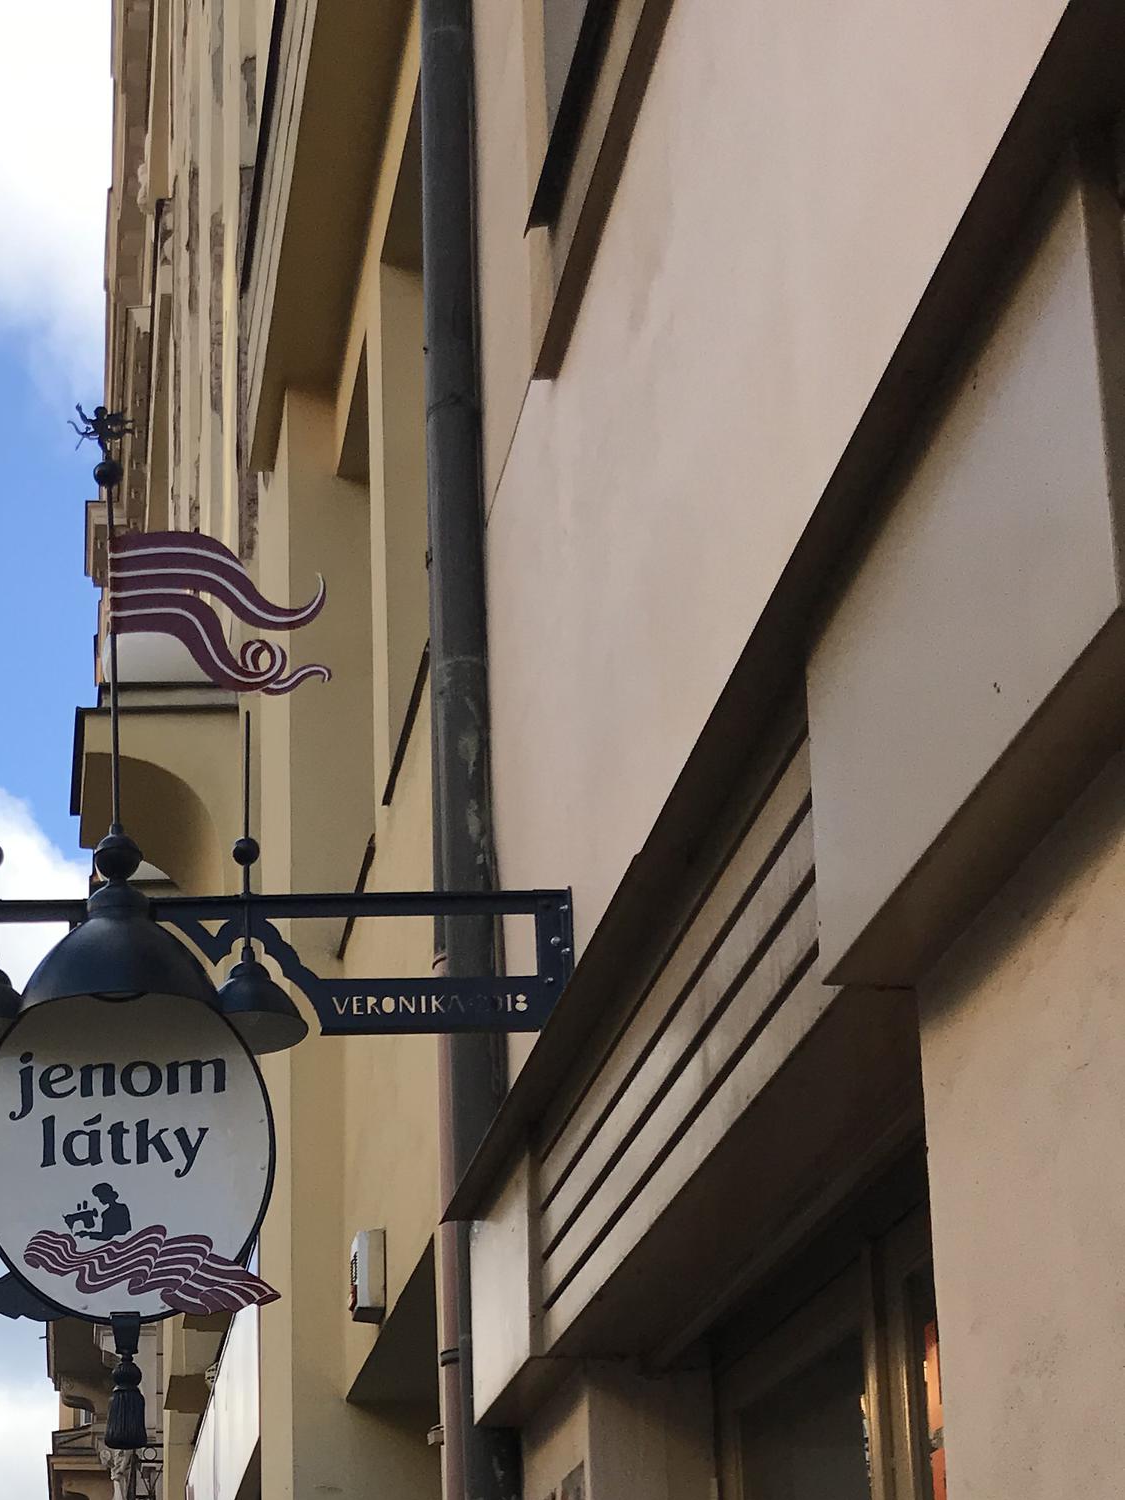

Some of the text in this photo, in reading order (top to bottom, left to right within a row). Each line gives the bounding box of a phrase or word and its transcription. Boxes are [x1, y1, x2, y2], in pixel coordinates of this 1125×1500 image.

[332, 994, 465, 1016] VERONIKA
[9, 1051, 226, 1121] jenom
[40, 1113, 210, 1178] látky
